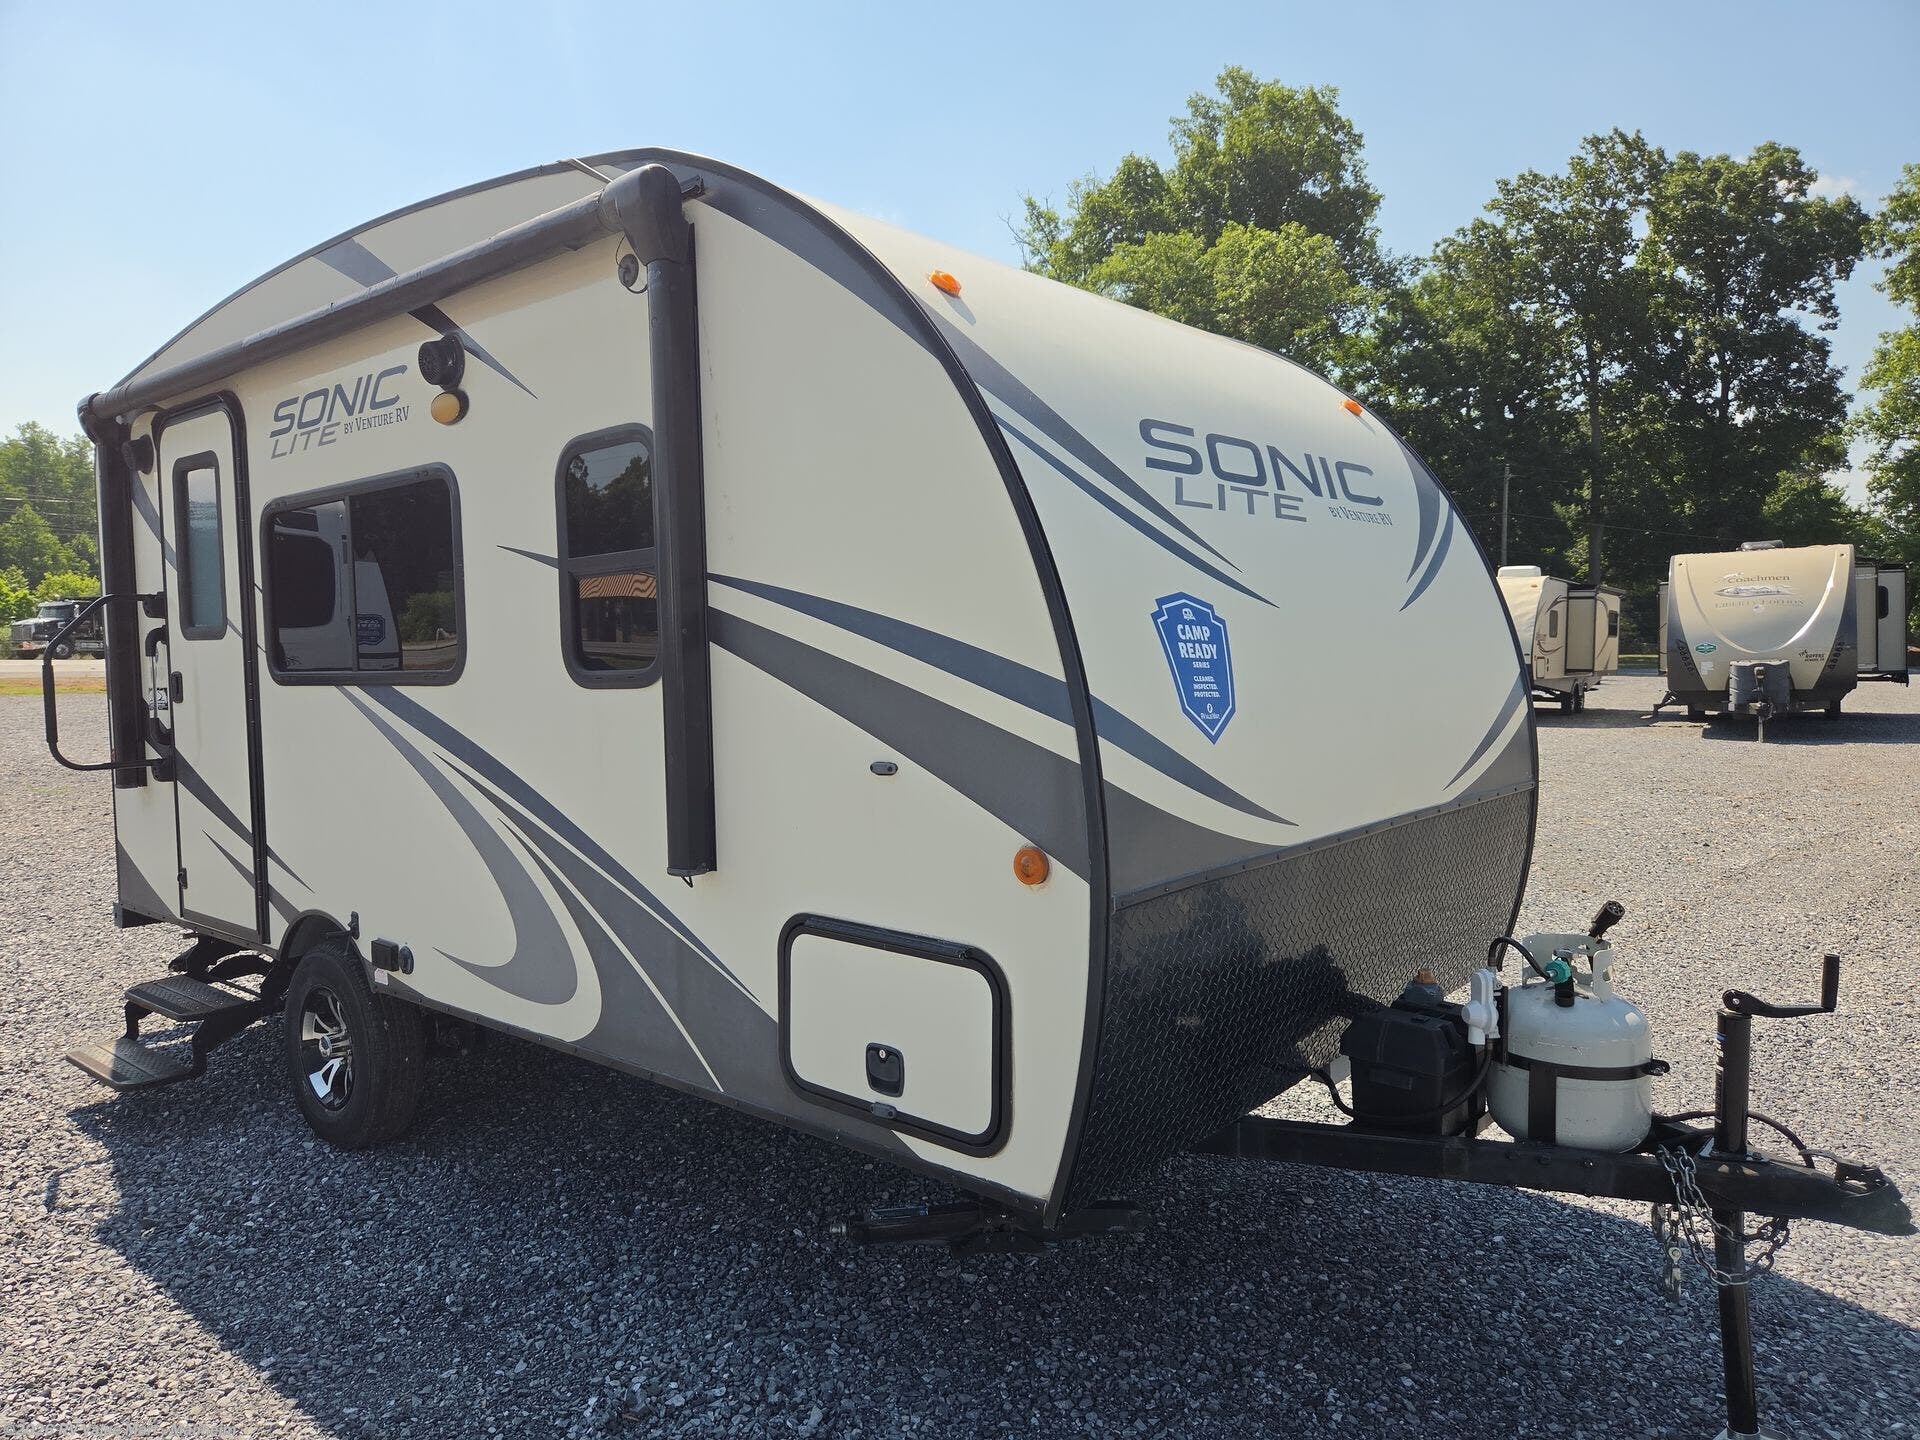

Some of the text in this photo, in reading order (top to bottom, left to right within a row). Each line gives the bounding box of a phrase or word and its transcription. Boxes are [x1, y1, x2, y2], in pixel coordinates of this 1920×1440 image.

[270, 365, 408, 438] SONIC
[344, 405, 410, 434] BY VENTURE RV
[271, 421, 341, 459] LITE
[1139, 418, 1384, 506] SONIC
[1175, 477, 1307, 523] LITE
[1328, 505, 1342, 519] BY
[1177, 624, 1210, 641] CAMP
[1178, 642, 1217, 660] READY
[1193, 661, 1210, 669] SERIES
